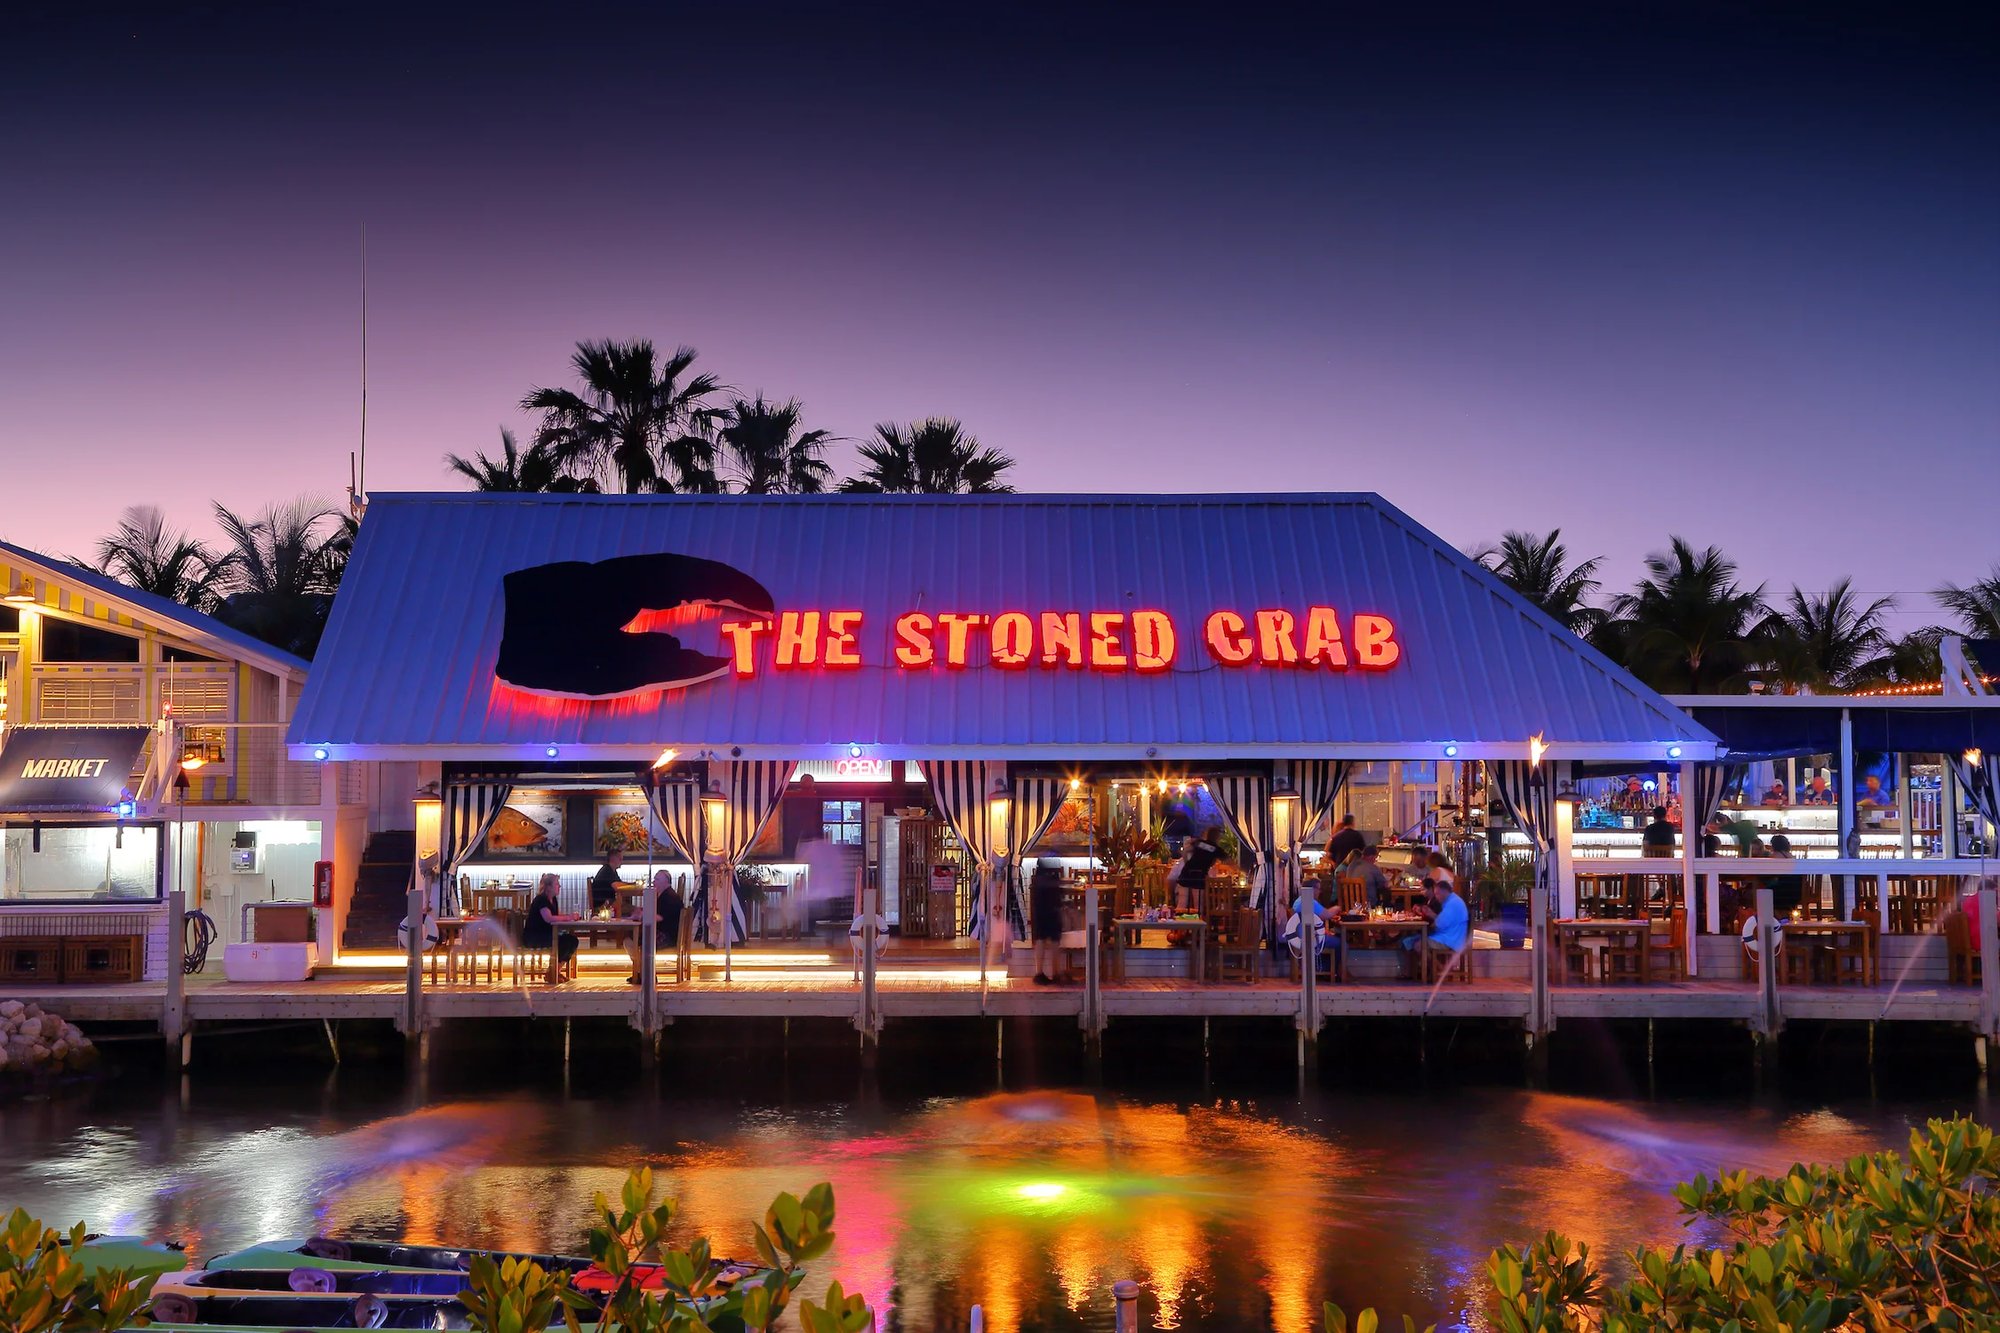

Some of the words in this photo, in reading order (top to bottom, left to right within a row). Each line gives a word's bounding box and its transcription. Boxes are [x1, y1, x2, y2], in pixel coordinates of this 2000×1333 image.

[722, 611, 862, 675] THE
[896, 611, 1175, 672] STONED
[1205, 606, 1400, 671] CRAB
[21, 759, 109, 778] MARKET
[837, 760, 880, 775] OPEN
